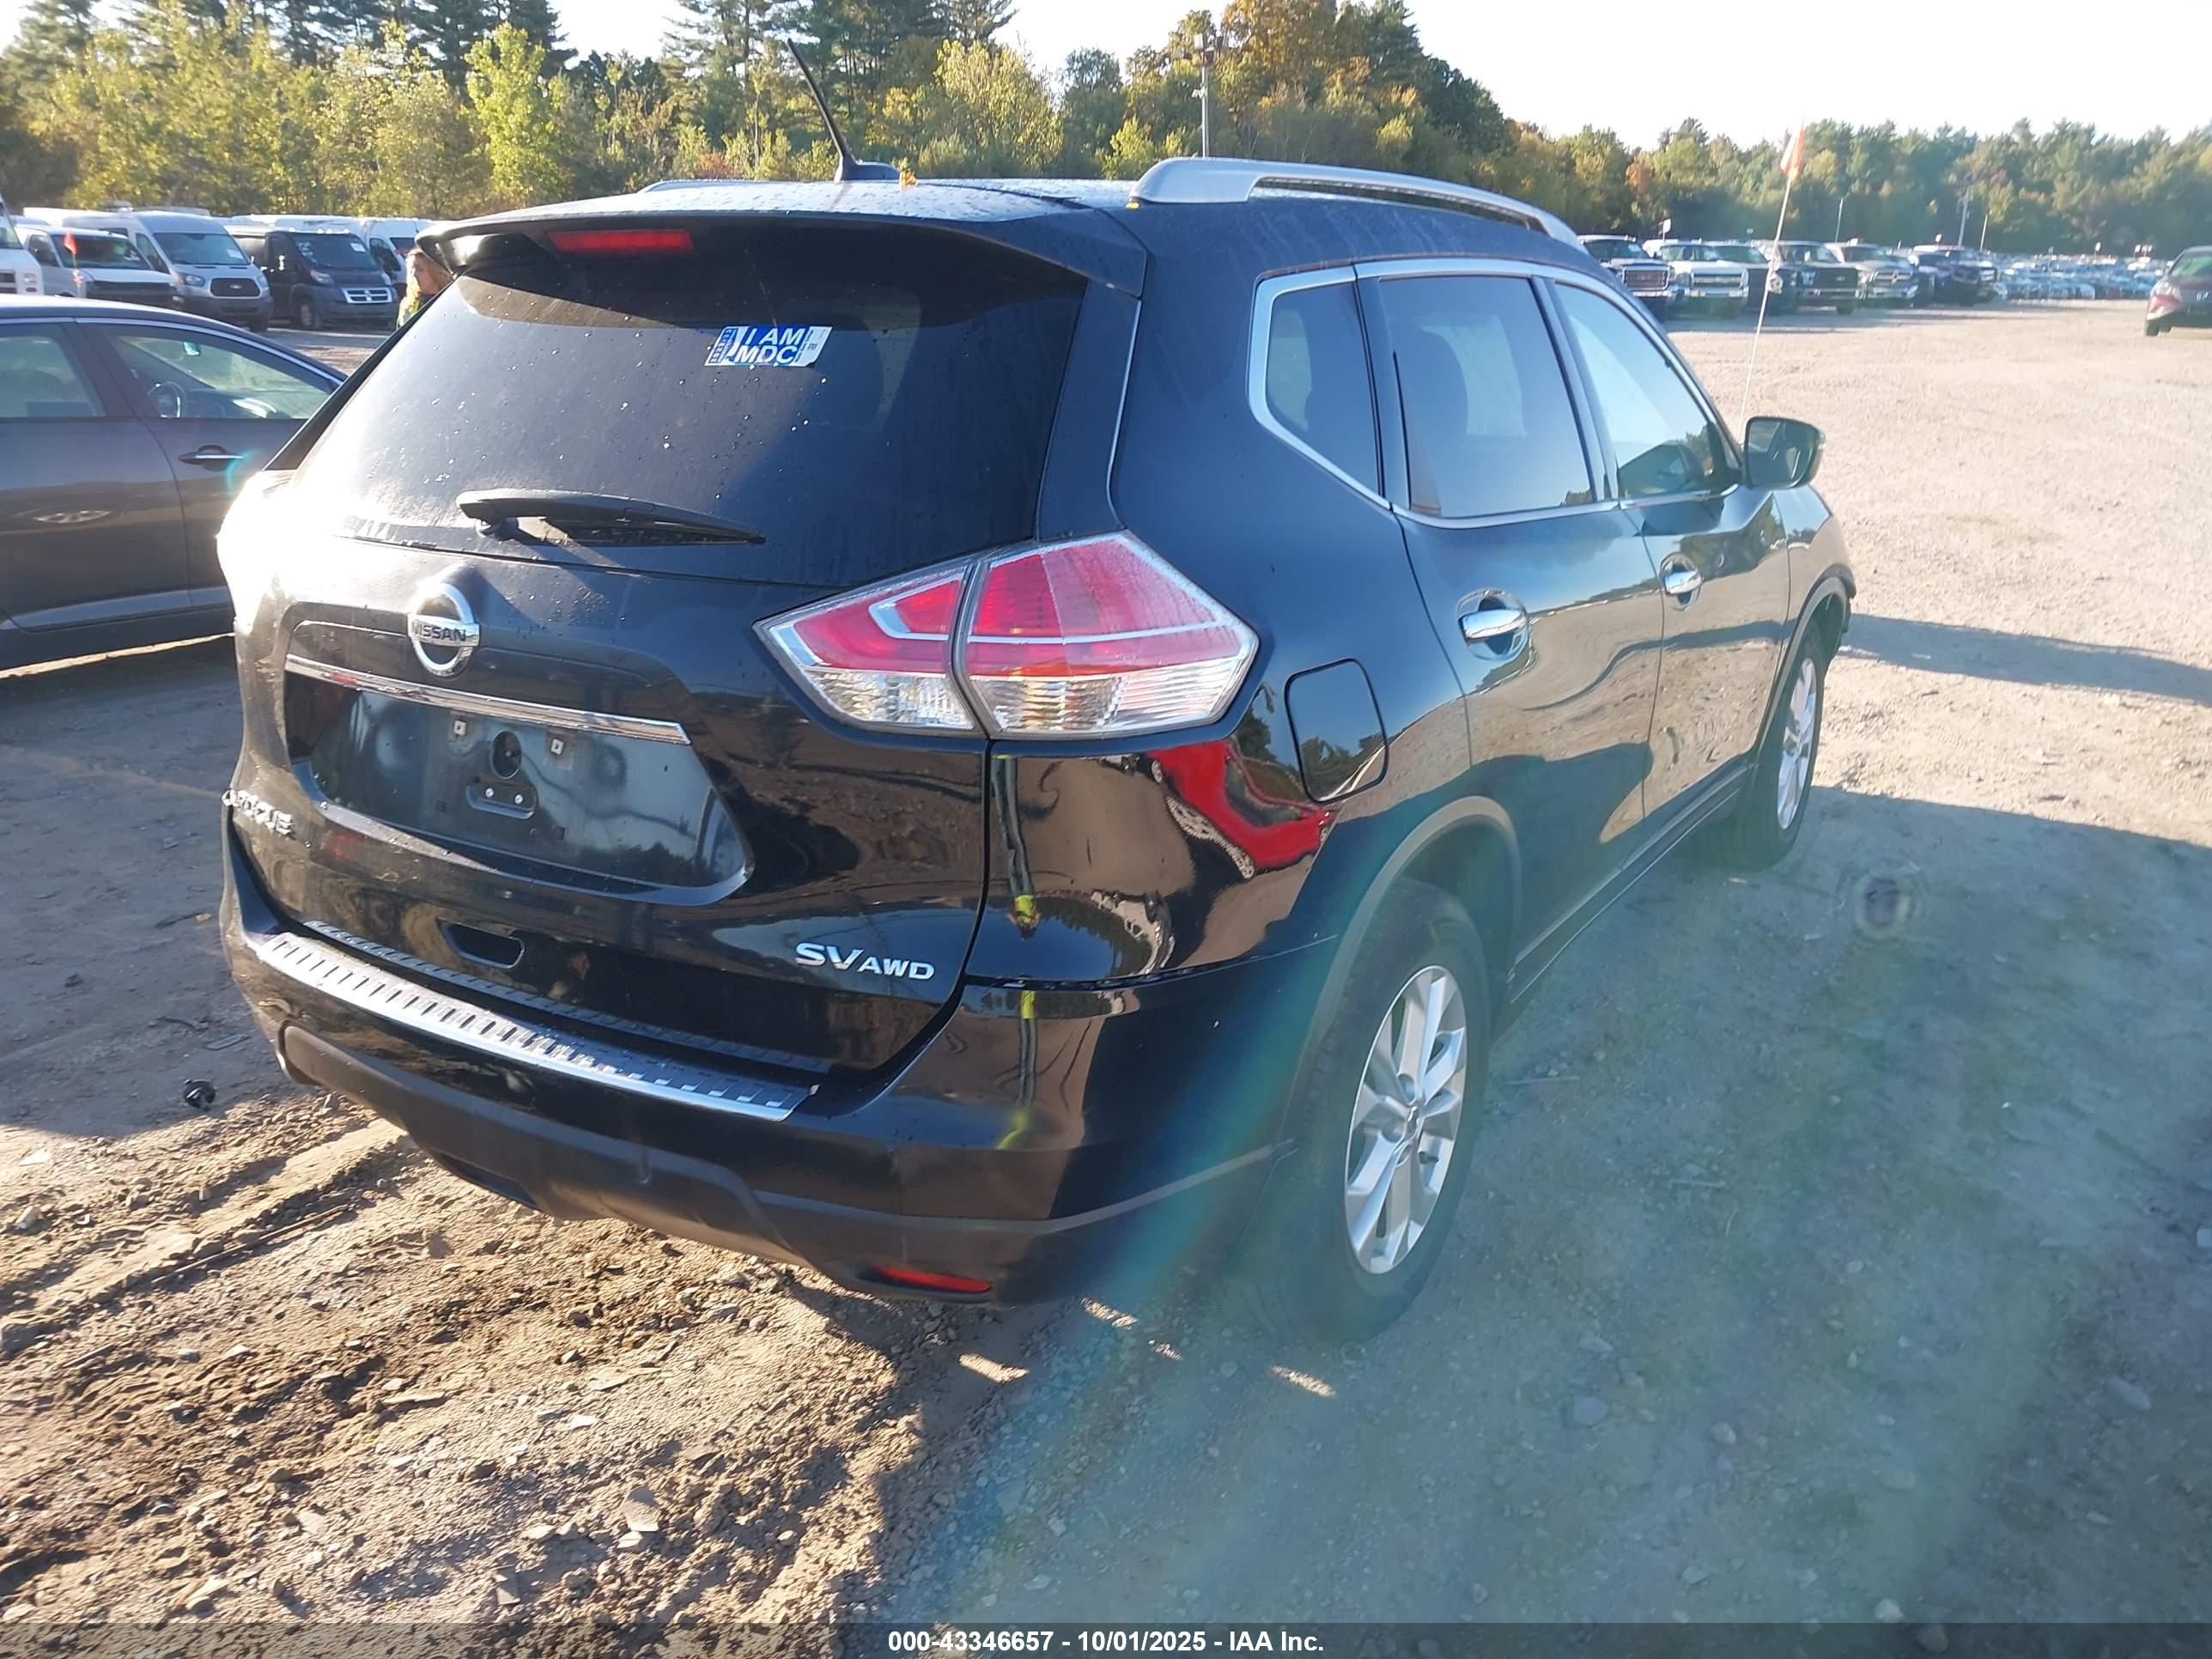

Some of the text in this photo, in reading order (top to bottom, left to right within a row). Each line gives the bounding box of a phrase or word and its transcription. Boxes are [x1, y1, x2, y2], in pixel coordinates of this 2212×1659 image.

[744, 327, 806, 345] I AM
[734, 345, 799, 364] MDC
[411, 618, 468, 642] NISSAN
[795, 942, 935, 980] SV AWD
